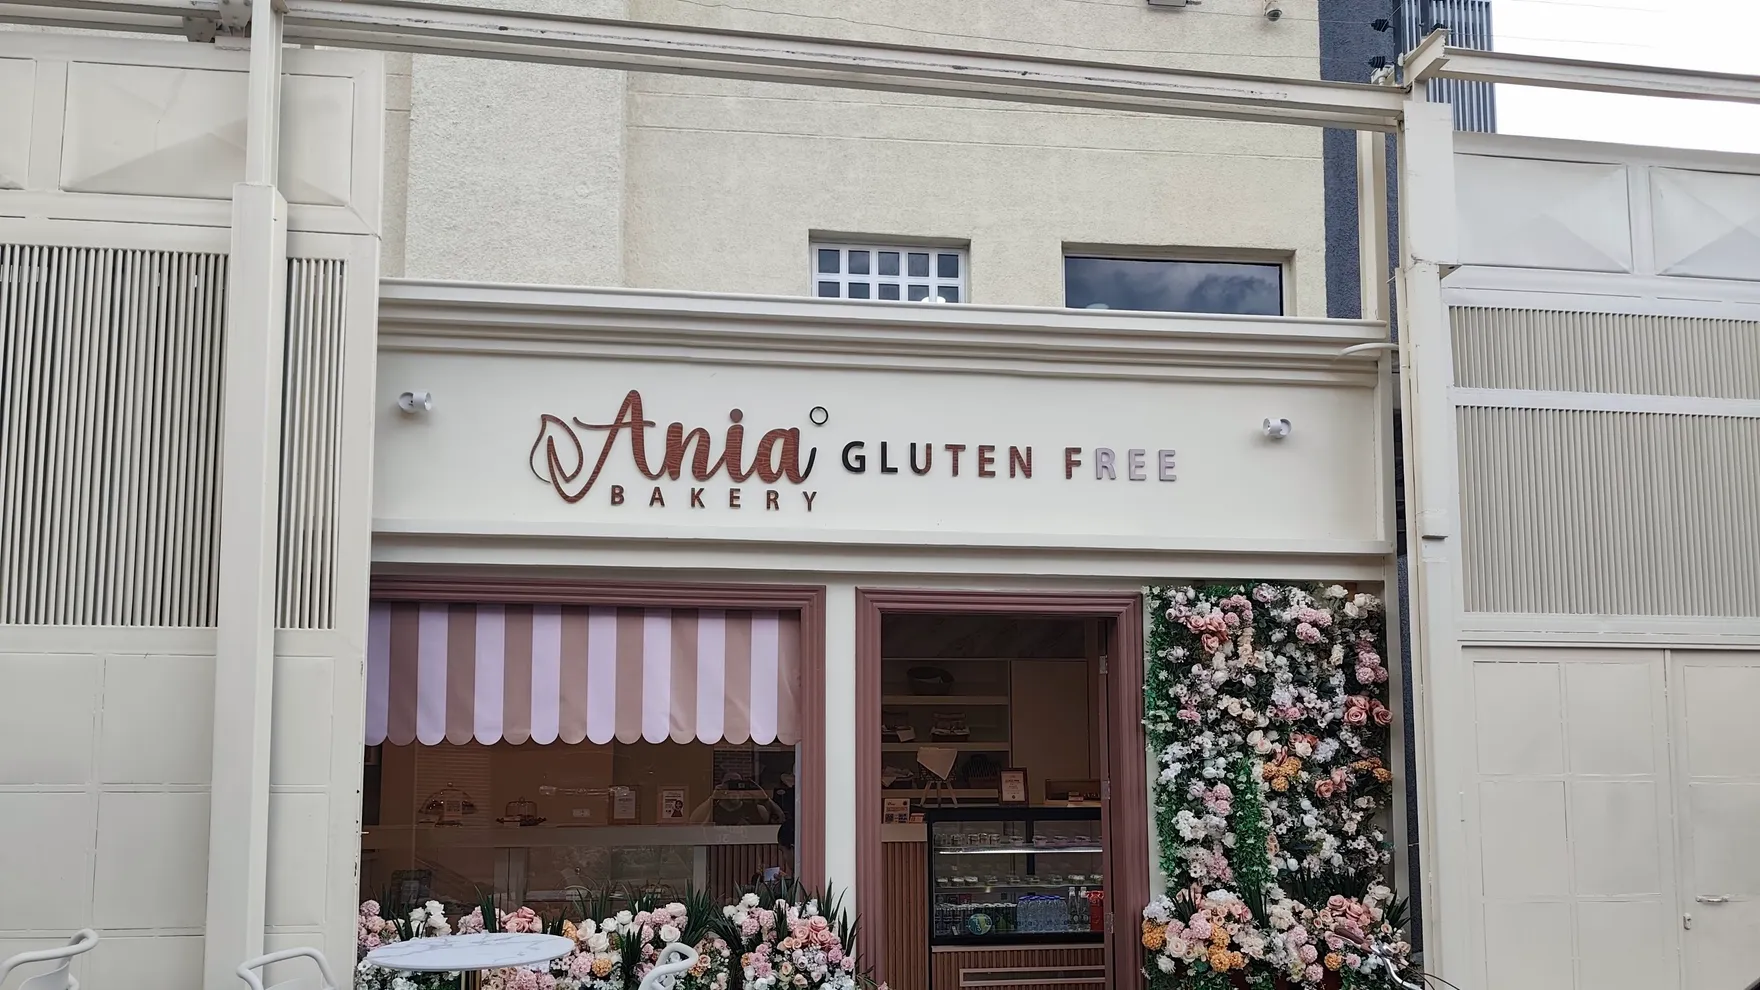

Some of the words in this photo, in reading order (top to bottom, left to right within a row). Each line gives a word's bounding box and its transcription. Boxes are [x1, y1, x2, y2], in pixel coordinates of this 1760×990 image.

[530, 389, 817, 504] Ania
[841, 440, 1033, 479] GLUTEN
[1064, 447, 1177, 482] FREE
[610, 484, 818, 512] BAKERY
